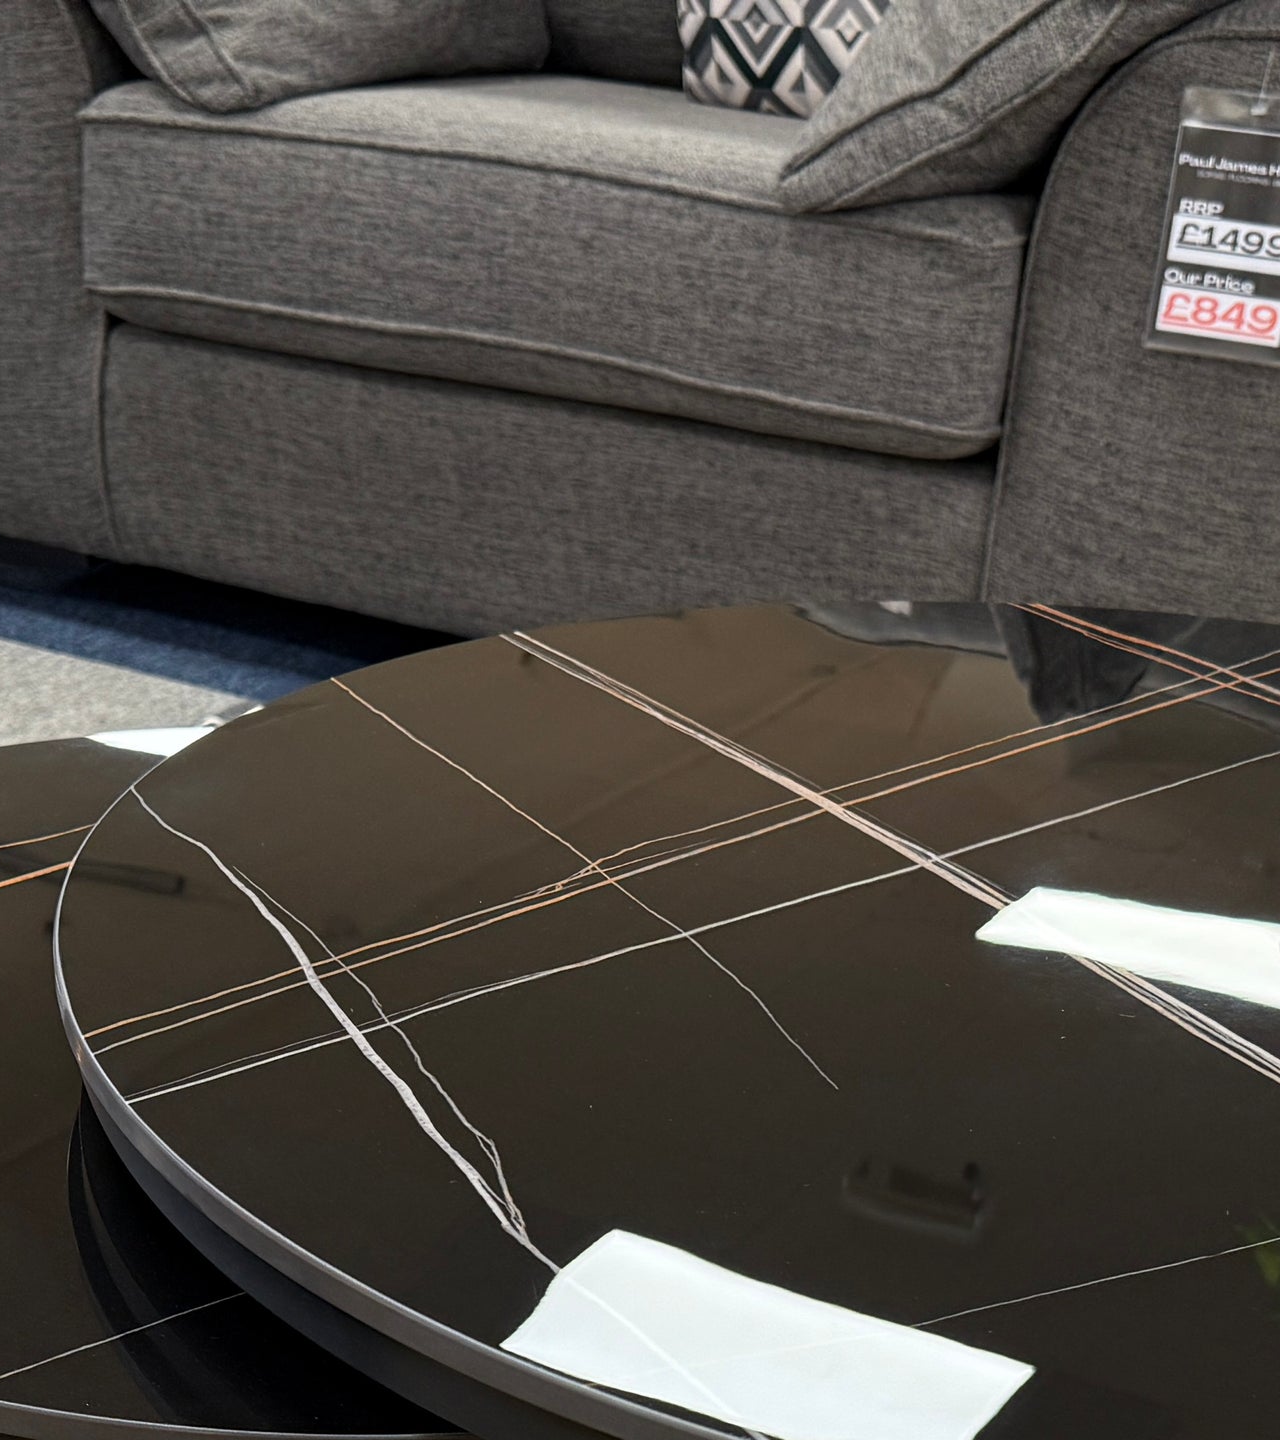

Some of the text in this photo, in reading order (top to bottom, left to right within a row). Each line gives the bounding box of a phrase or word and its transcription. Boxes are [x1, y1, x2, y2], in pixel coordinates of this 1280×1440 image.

[1179, 153, 1214, 169] Paul
[1214, 157, 1267, 176] James
[1180, 199, 1224, 216] RRP
[1165, 267, 1255, 294] Our Price
[1163, 293, 1278, 335] £849
